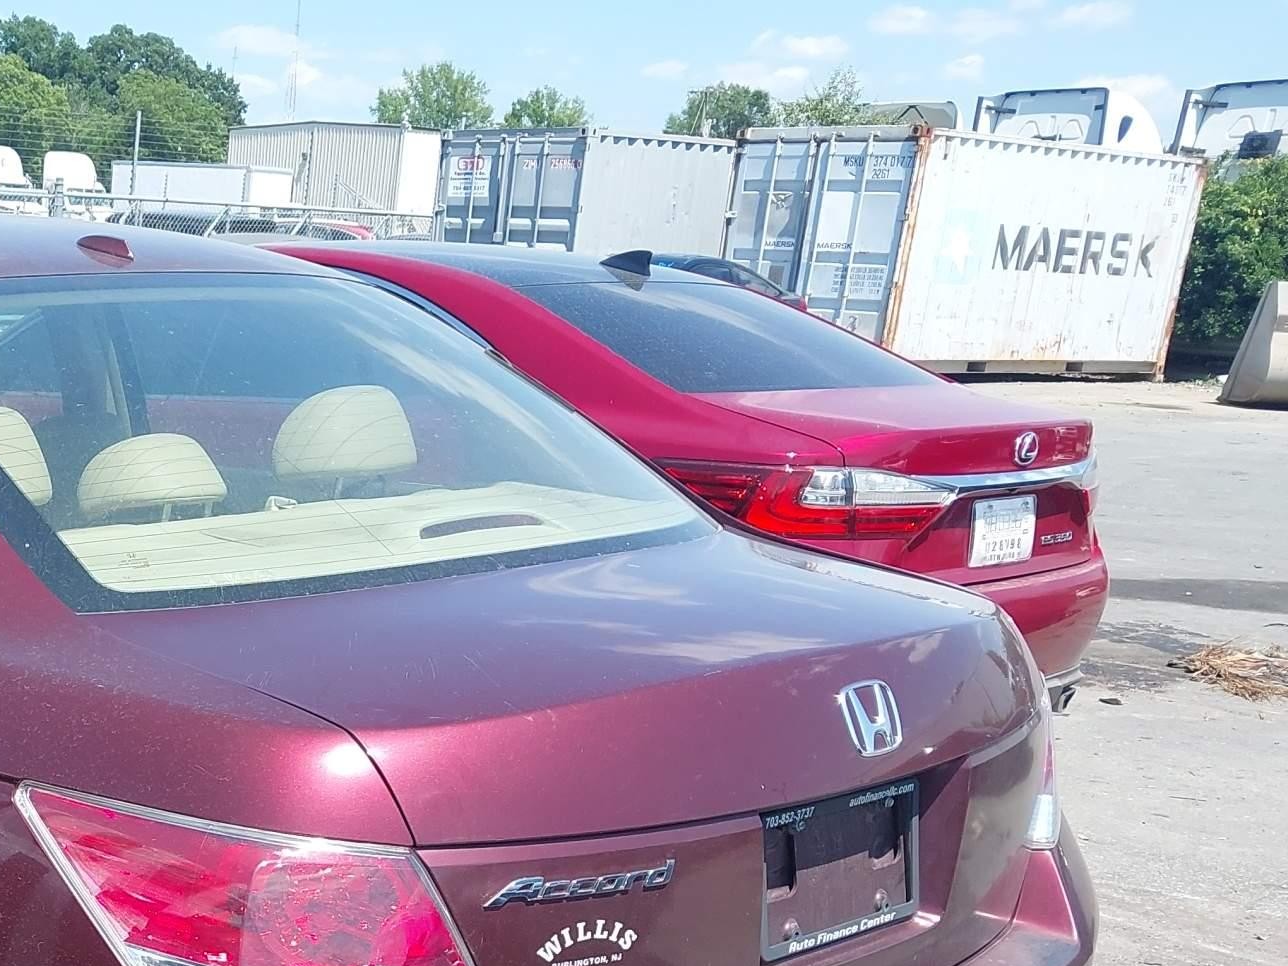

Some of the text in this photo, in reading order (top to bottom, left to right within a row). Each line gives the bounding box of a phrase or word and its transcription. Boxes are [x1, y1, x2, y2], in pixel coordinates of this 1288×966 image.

[843, 155, 864, 167] MSKU
[816, 241, 853, 250] MAERSK
[991, 223, 1161, 278] MAERSK
[765, 806, 815, 830] 703-852-3737
[483, 857, 676, 911] Accord
[536, 919, 638, 963] WILLIS
[788, 911, 897, 953] Auto Finance Center
[610, 952, 623, 963] NJ
